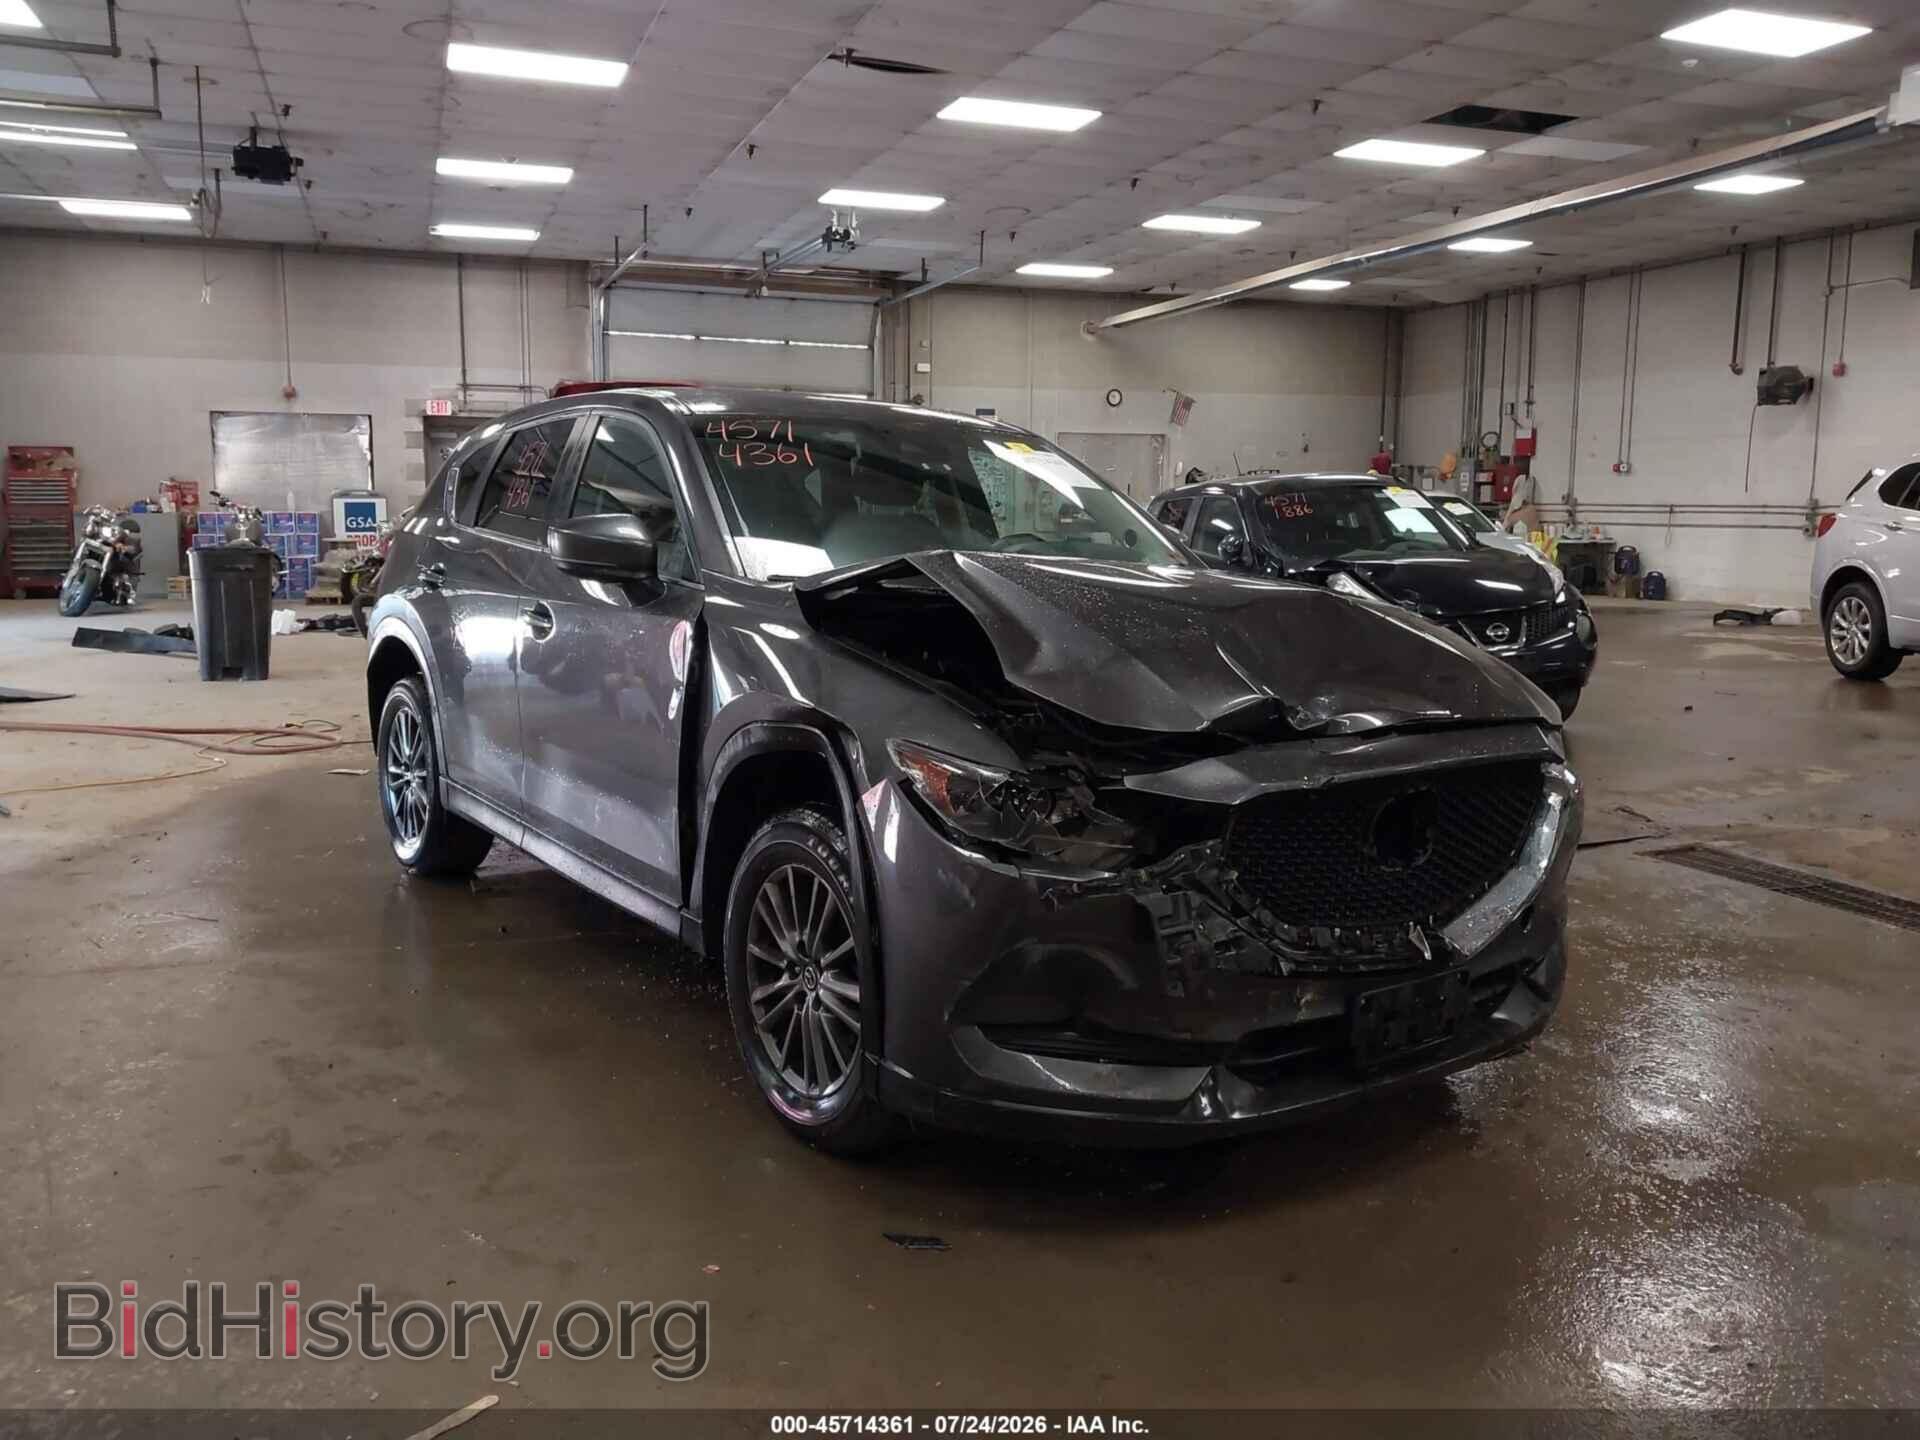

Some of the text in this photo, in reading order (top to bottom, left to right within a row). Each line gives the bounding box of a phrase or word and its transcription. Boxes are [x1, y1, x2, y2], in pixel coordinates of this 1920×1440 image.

[706, 419, 793, 442] 4571
[718, 442, 814, 467] 4361
[1274, 503, 1314, 520] 1886
[346, 516, 375, 529] GSA
